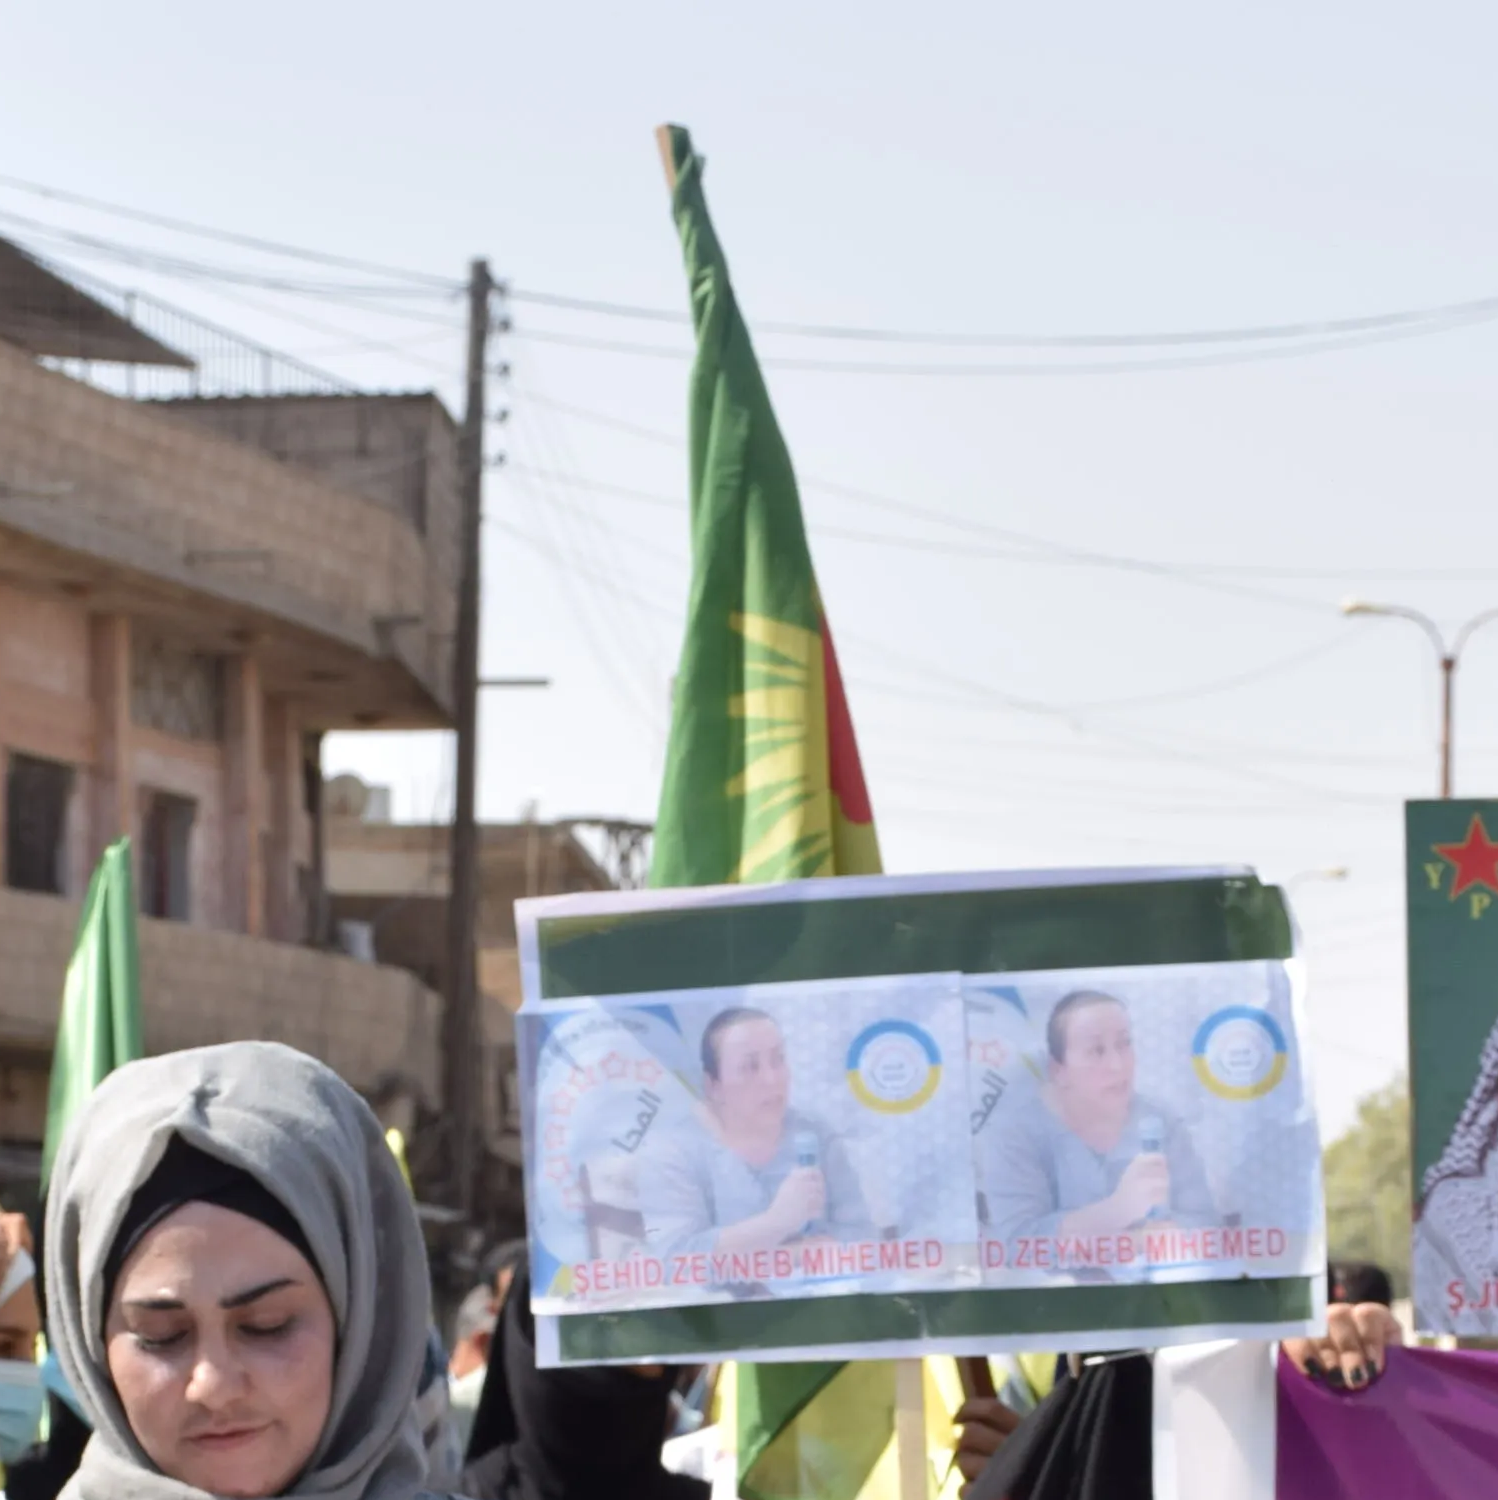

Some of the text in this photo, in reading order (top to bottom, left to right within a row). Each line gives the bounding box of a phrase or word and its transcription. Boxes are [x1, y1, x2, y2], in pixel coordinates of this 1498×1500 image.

[1424, 862, 1445, 889] Y
[1470, 893, 1492, 920] P
[672, 1250, 793, 1286] ZEYNEB
[804, 1238, 944, 1275] MIHEMED
[1015, 1235, 1134, 1269] ZEYNEB
[1146, 1227, 1288, 1263] MIHEMED
